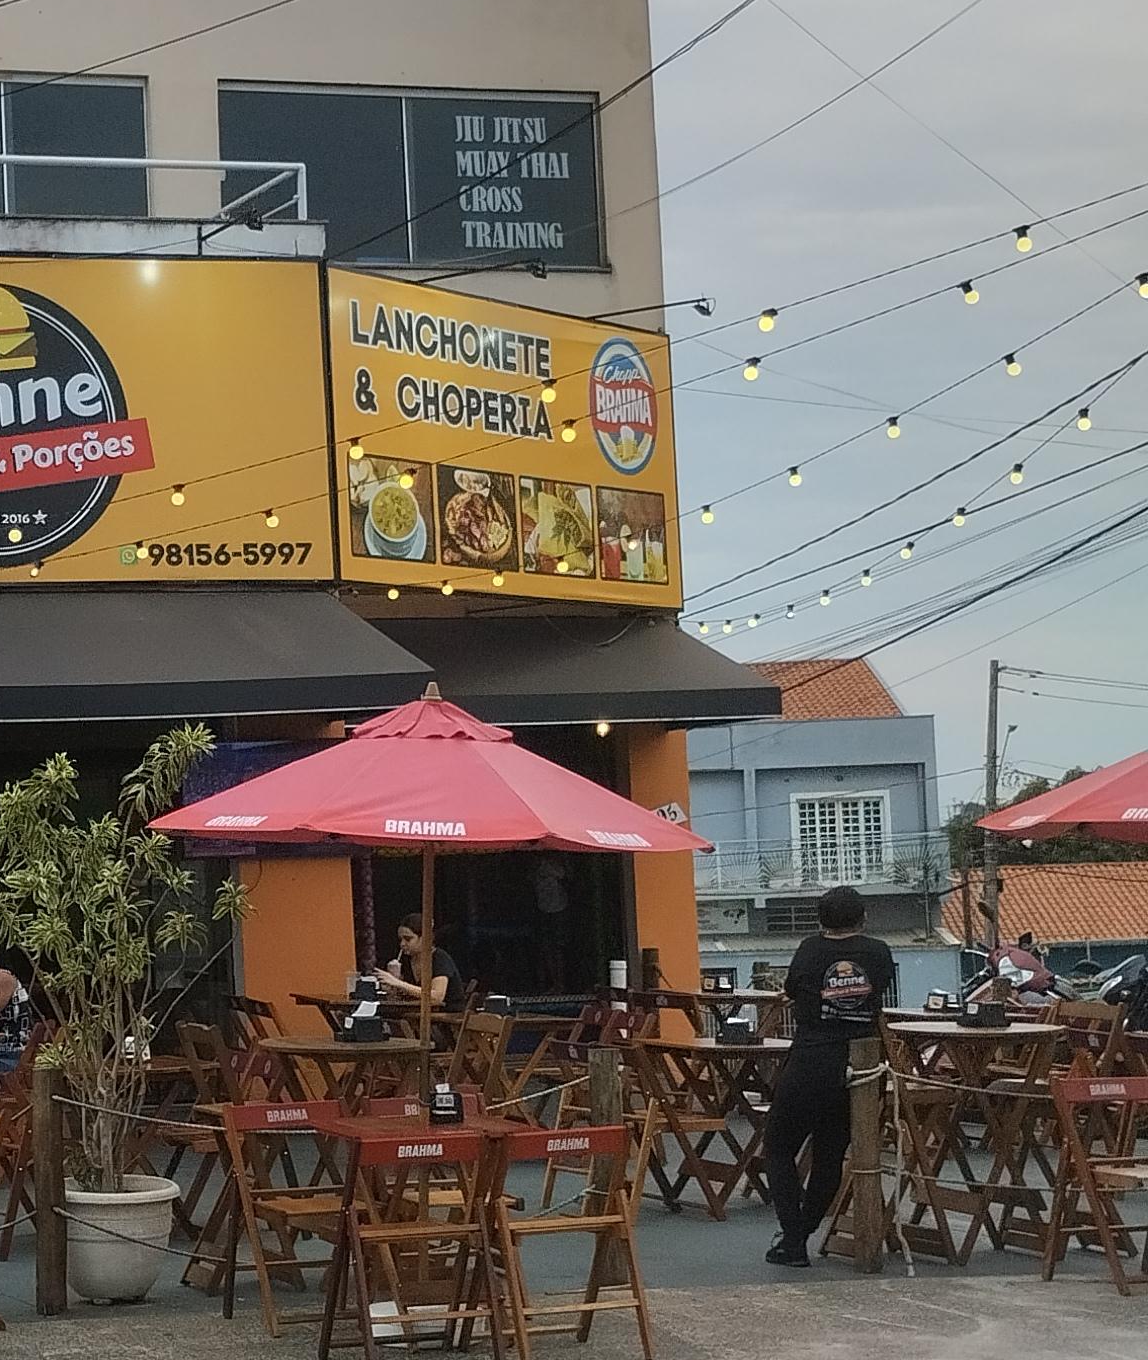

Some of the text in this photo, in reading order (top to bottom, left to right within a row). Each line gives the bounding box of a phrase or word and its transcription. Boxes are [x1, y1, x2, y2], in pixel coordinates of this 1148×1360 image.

[455, 116, 547, 144] JIU JITSU
[456, 151, 570, 179] MUAY THAI
[459, 186, 523, 213] CROSS
[462, 221, 564, 249] TRAINING
[349, 299, 551, 380] LANCHONETE
[603, 365, 641, 386] Chopp
[354, 366, 554, 441] & CHOPERIA
[595, 383, 652, 427] BRAHMA
[12, 430, 136, 473] Porções
[1, 513, 30, 524] 2016
[148, 542, 313, 566] 98156-5997
[384, 819, 467, 836] BRAHMA
[266, 1108, 309, 1123] BRAHMA
[397, 1143, 443, 1158] BRAHMA
[546, 1137, 590, 1152] BRAHMA
